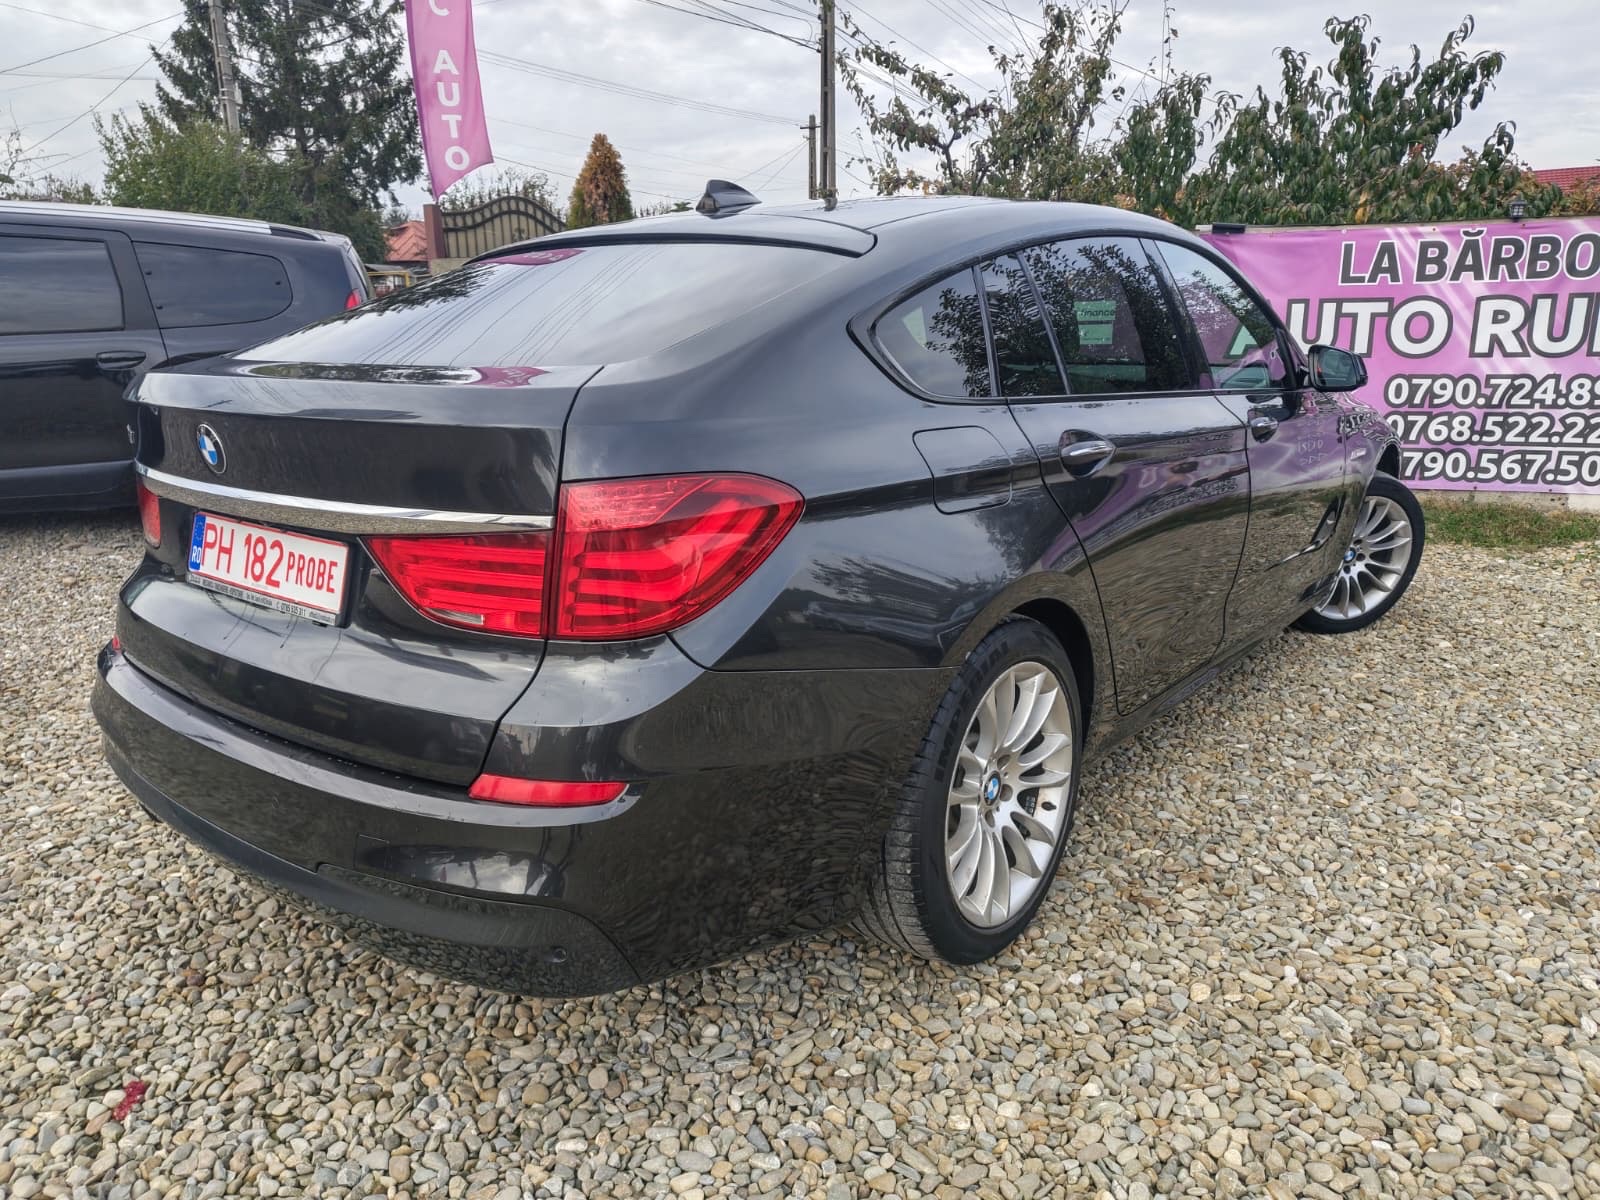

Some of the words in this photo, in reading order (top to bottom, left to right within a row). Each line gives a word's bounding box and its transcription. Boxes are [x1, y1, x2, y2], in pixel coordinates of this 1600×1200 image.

[433, 50, 470, 171] AUTO
[1338, 240, 1403, 285] LA
[1415, 227, 1600, 284] BĂRBO
[1469, 292, 1600, 359] RU
[191, 545, 201, 564] RO
[202, 522, 234, 574] PH
[244, 533, 284, 589] 182
[285, 551, 338, 594] PROBE
